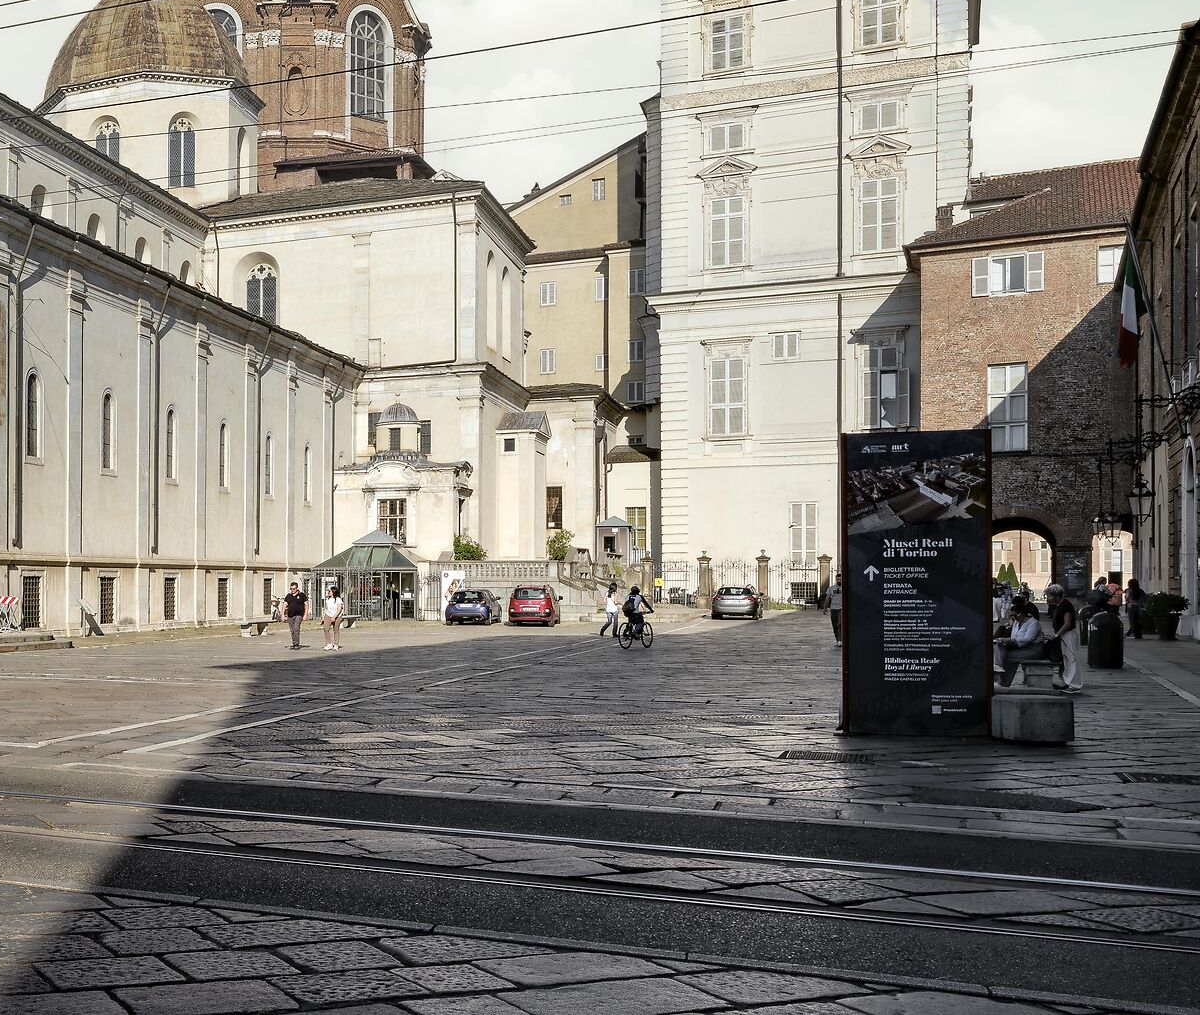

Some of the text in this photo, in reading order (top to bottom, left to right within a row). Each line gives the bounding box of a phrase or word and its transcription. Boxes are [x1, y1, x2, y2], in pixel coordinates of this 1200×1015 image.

[883, 538, 953, 548] Musei Reali
[883, 548, 938, 557] di Torino
[885, 664, 933, 672] Royal Library
